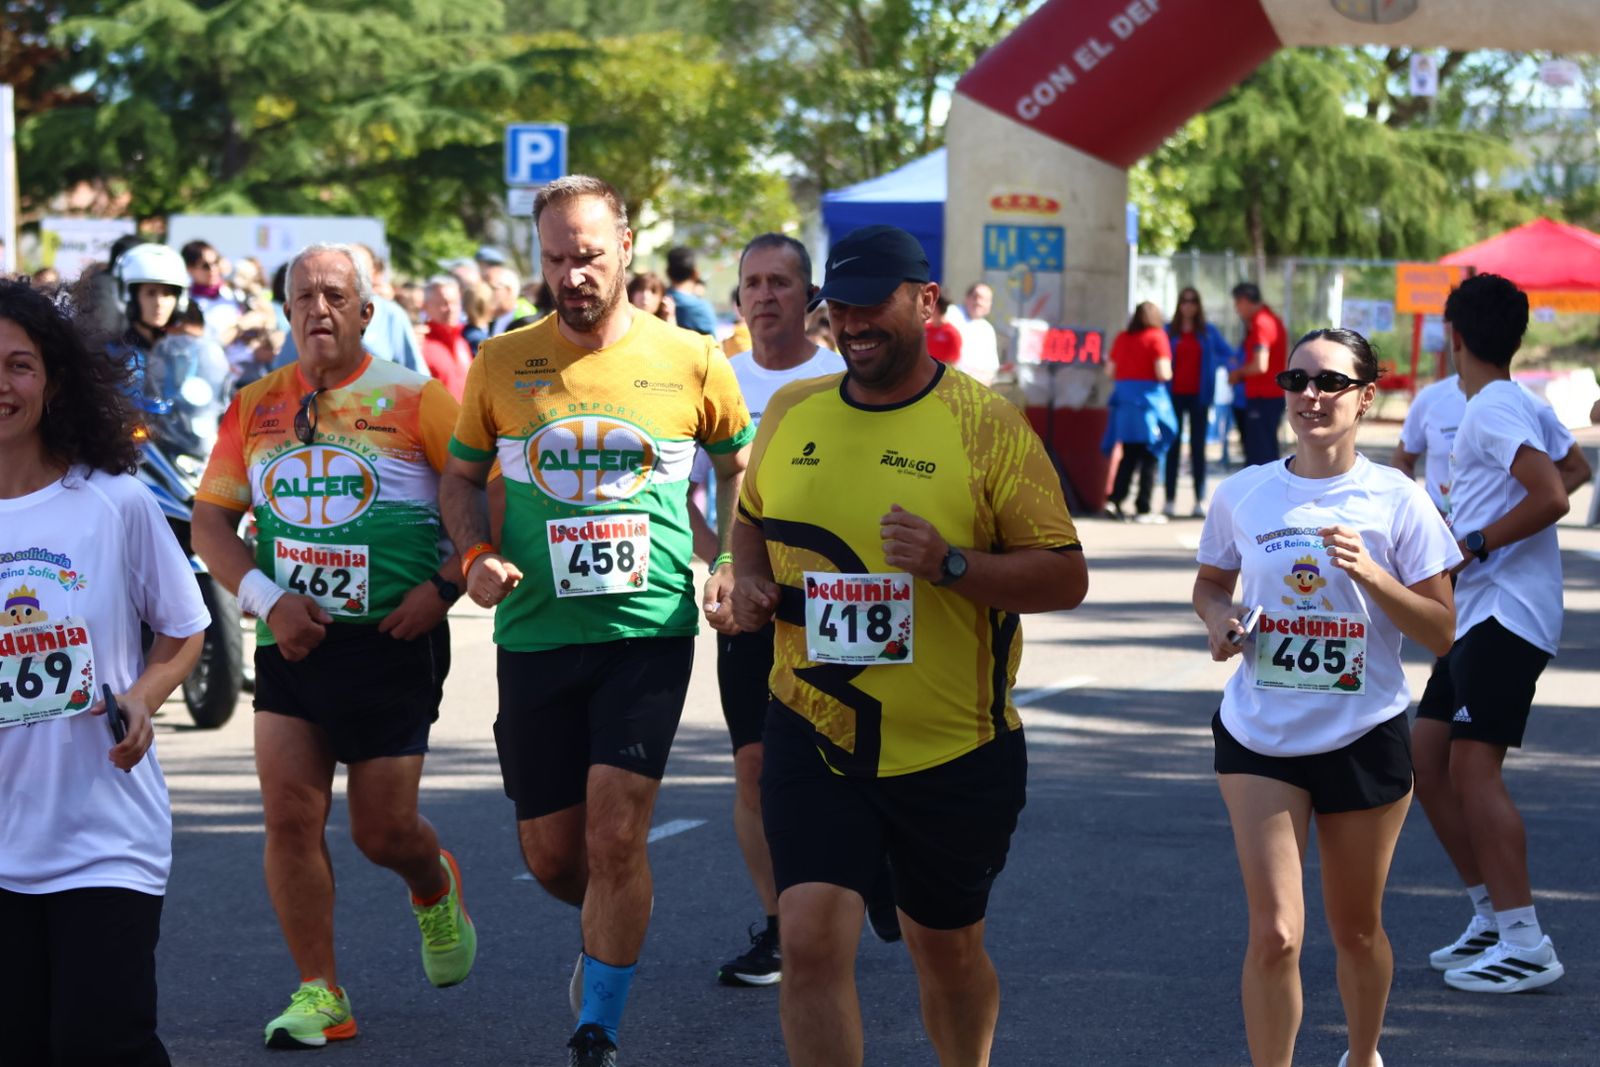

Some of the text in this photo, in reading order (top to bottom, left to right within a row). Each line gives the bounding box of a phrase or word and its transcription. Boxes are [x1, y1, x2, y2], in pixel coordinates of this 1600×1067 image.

[1015, 63, 1076, 120] CON
[1073, 37, 1115, 71] EL
[518, 131, 555, 181] P
[522, 402, 662, 436] CLUB DEPORTIVO
[261, 432, 377, 465] CLUB PORTIVO
[537, 448, 645, 472] ALCER
[791, 457, 820, 466] VIATOR
[272, 475, 366, 500] ALCER
[549, 519, 647, 544] bedunia
[1265, 542, 1282, 553] CEE
[1284, 540, 1311, 549] Reina
[276, 541, 367, 568] bedunia
[568, 540, 635, 577] 458
[288, 564, 352, 599] 462
[806, 577, 911, 602] bedunia
[818, 603, 892, 643] 418
[1259, 614, 1365, 639] bedunia
[1272, 636, 1347, 675] 465
